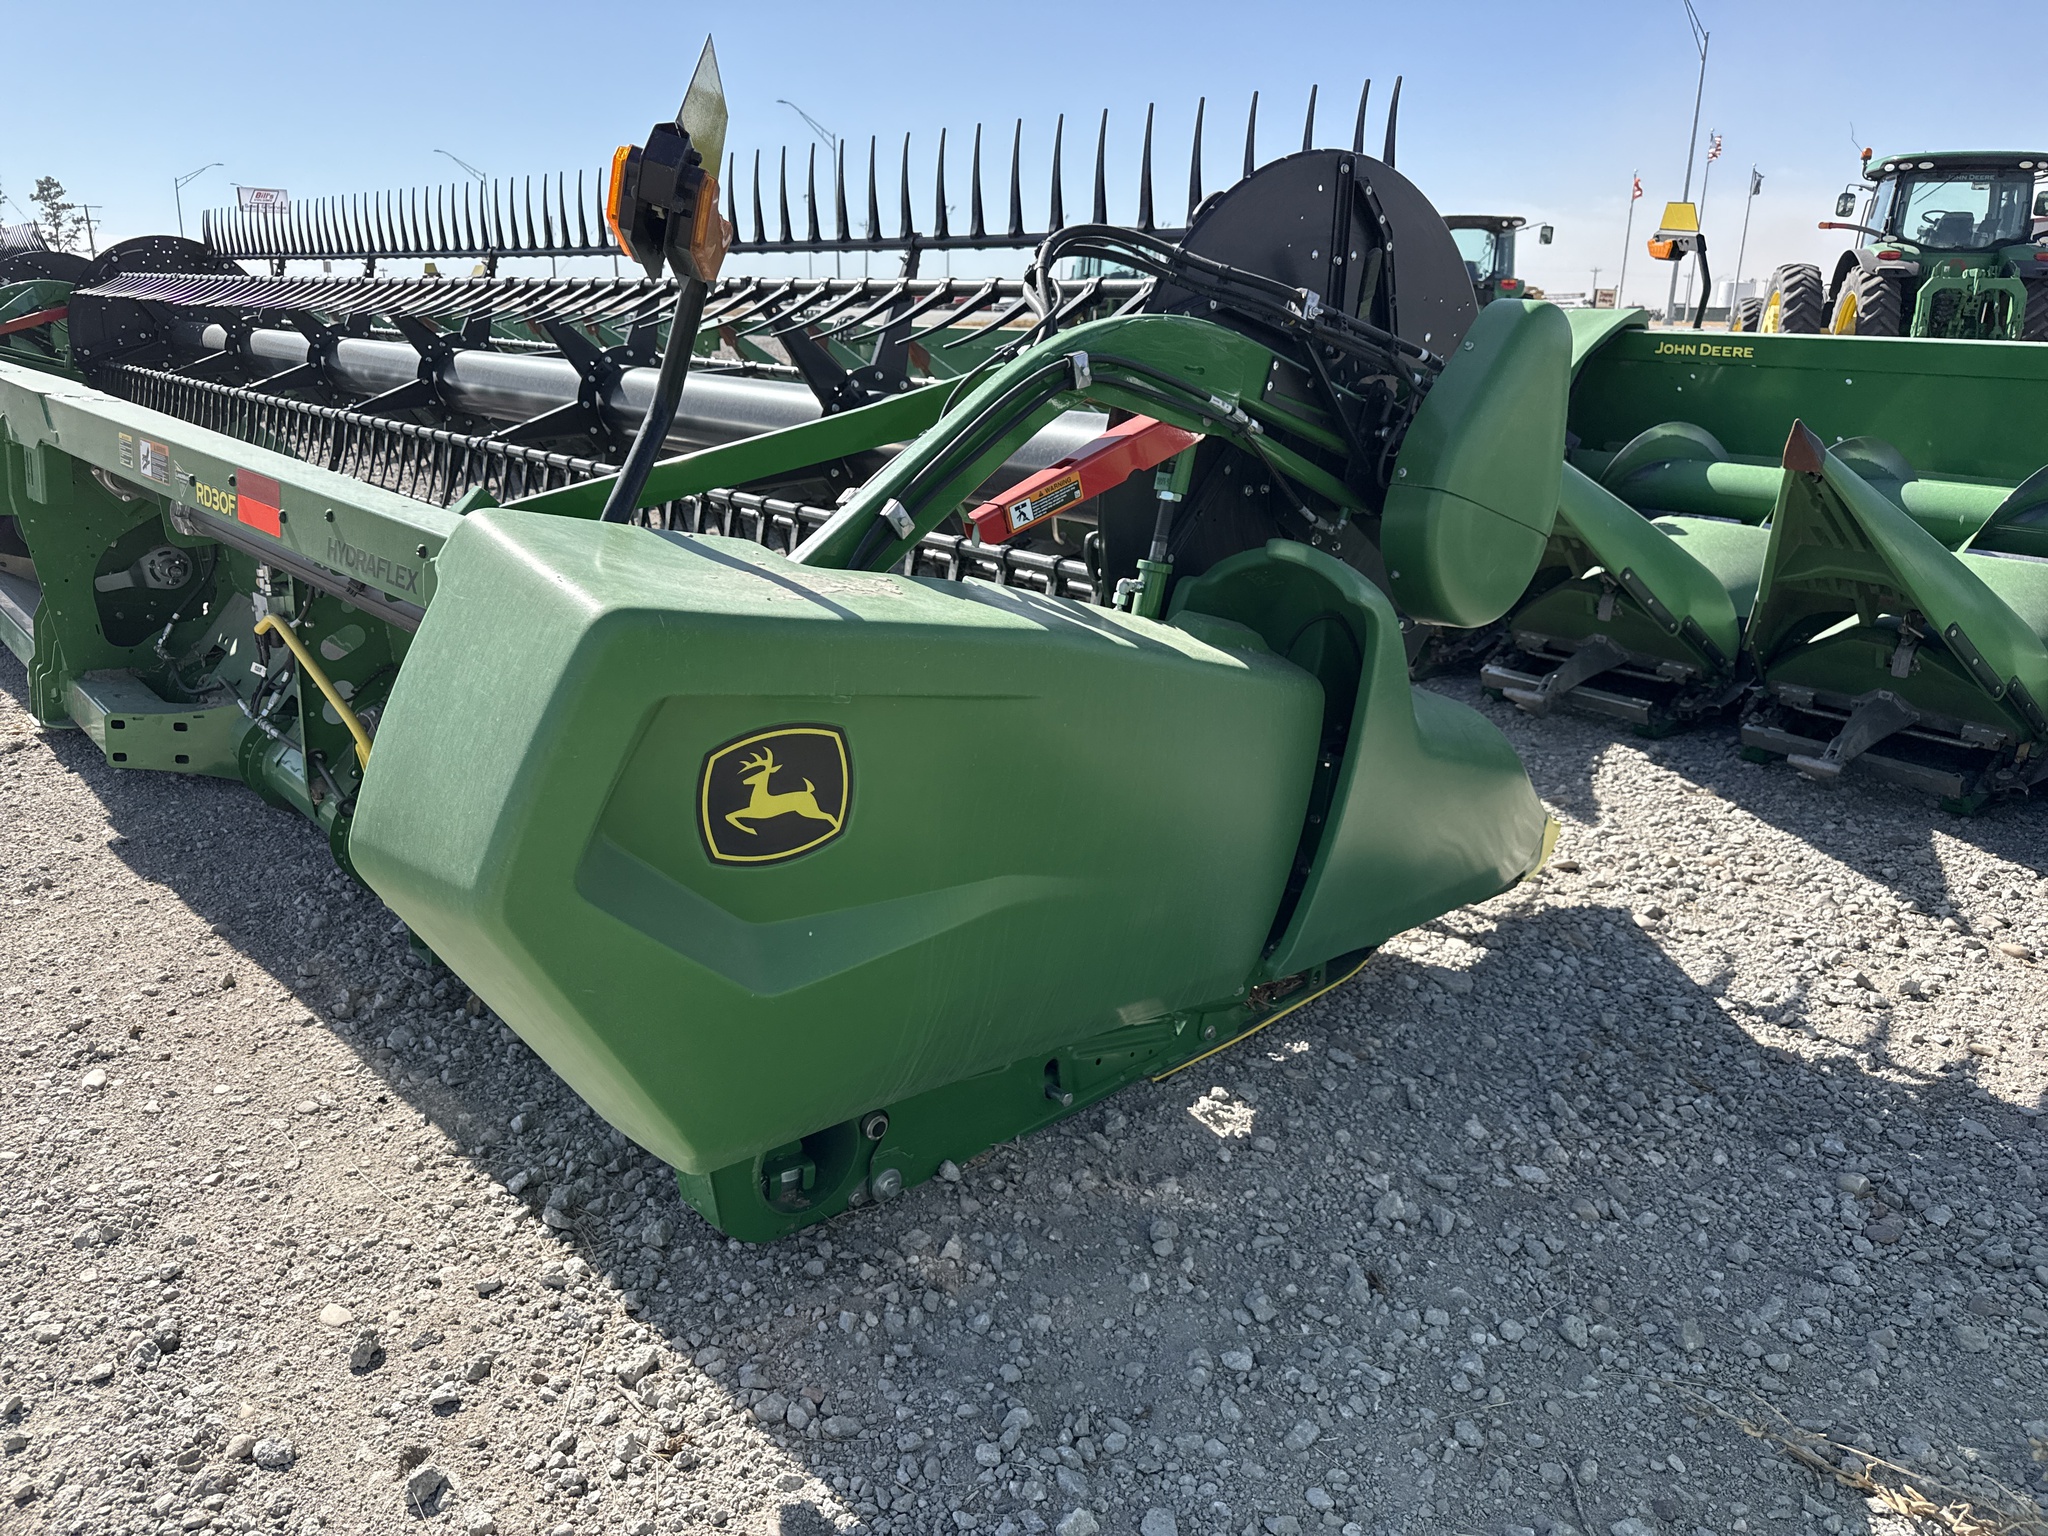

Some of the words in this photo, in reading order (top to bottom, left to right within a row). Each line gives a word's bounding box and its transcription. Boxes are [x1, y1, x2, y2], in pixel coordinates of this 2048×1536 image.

[1654, 341, 1697, 355] JOHN
[1699, 342, 1755, 358] DEERE
[1044, 476, 1072, 493] WARNING
[195, 482, 237, 516] RD30F
[326, 537, 419, 595] HYDRAFLEX
